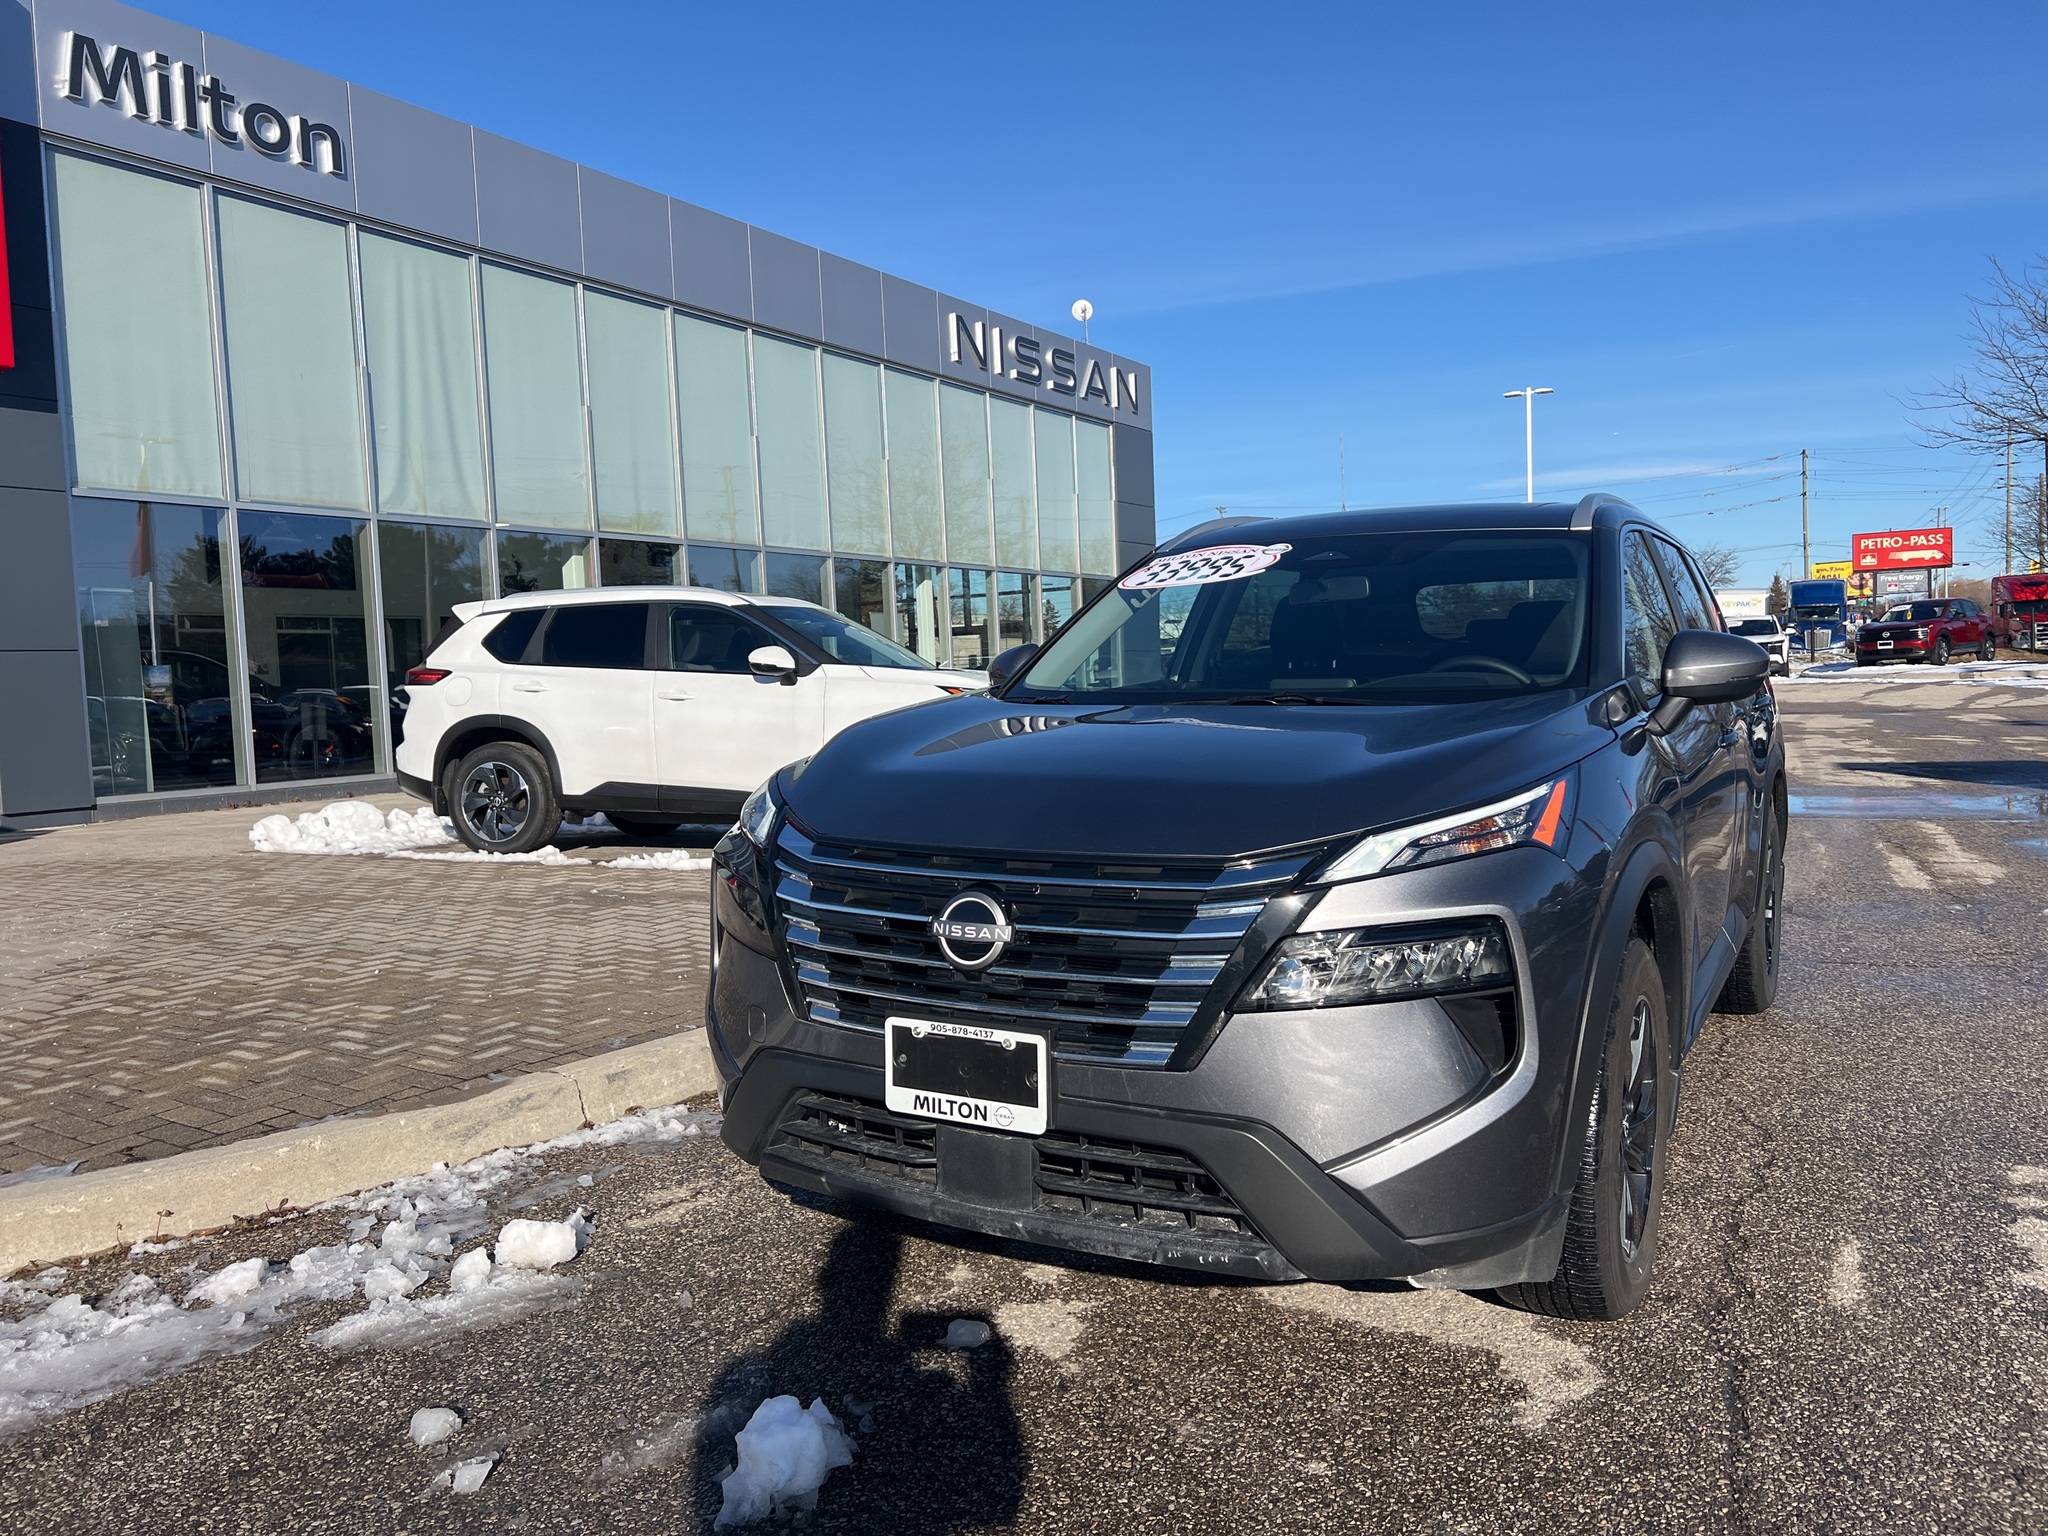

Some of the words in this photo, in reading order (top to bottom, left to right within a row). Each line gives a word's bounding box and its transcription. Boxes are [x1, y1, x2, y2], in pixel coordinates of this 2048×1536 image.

[64, 30, 345, 175] Milton
[949, 312, 1138, 414] NISSAN
[1860, 533, 1944, 550] PETRO-PASS
[1157, 552, 1205, 563] MILTON
[1208, 548, 1260, 557] NISSAN
[1899, 574, 1924, 582] Energy
[932, 921, 1011, 941] NISSAN
[930, 1023, 994, 1039] 905-878-4137
[913, 1094, 988, 1122] MILTON
